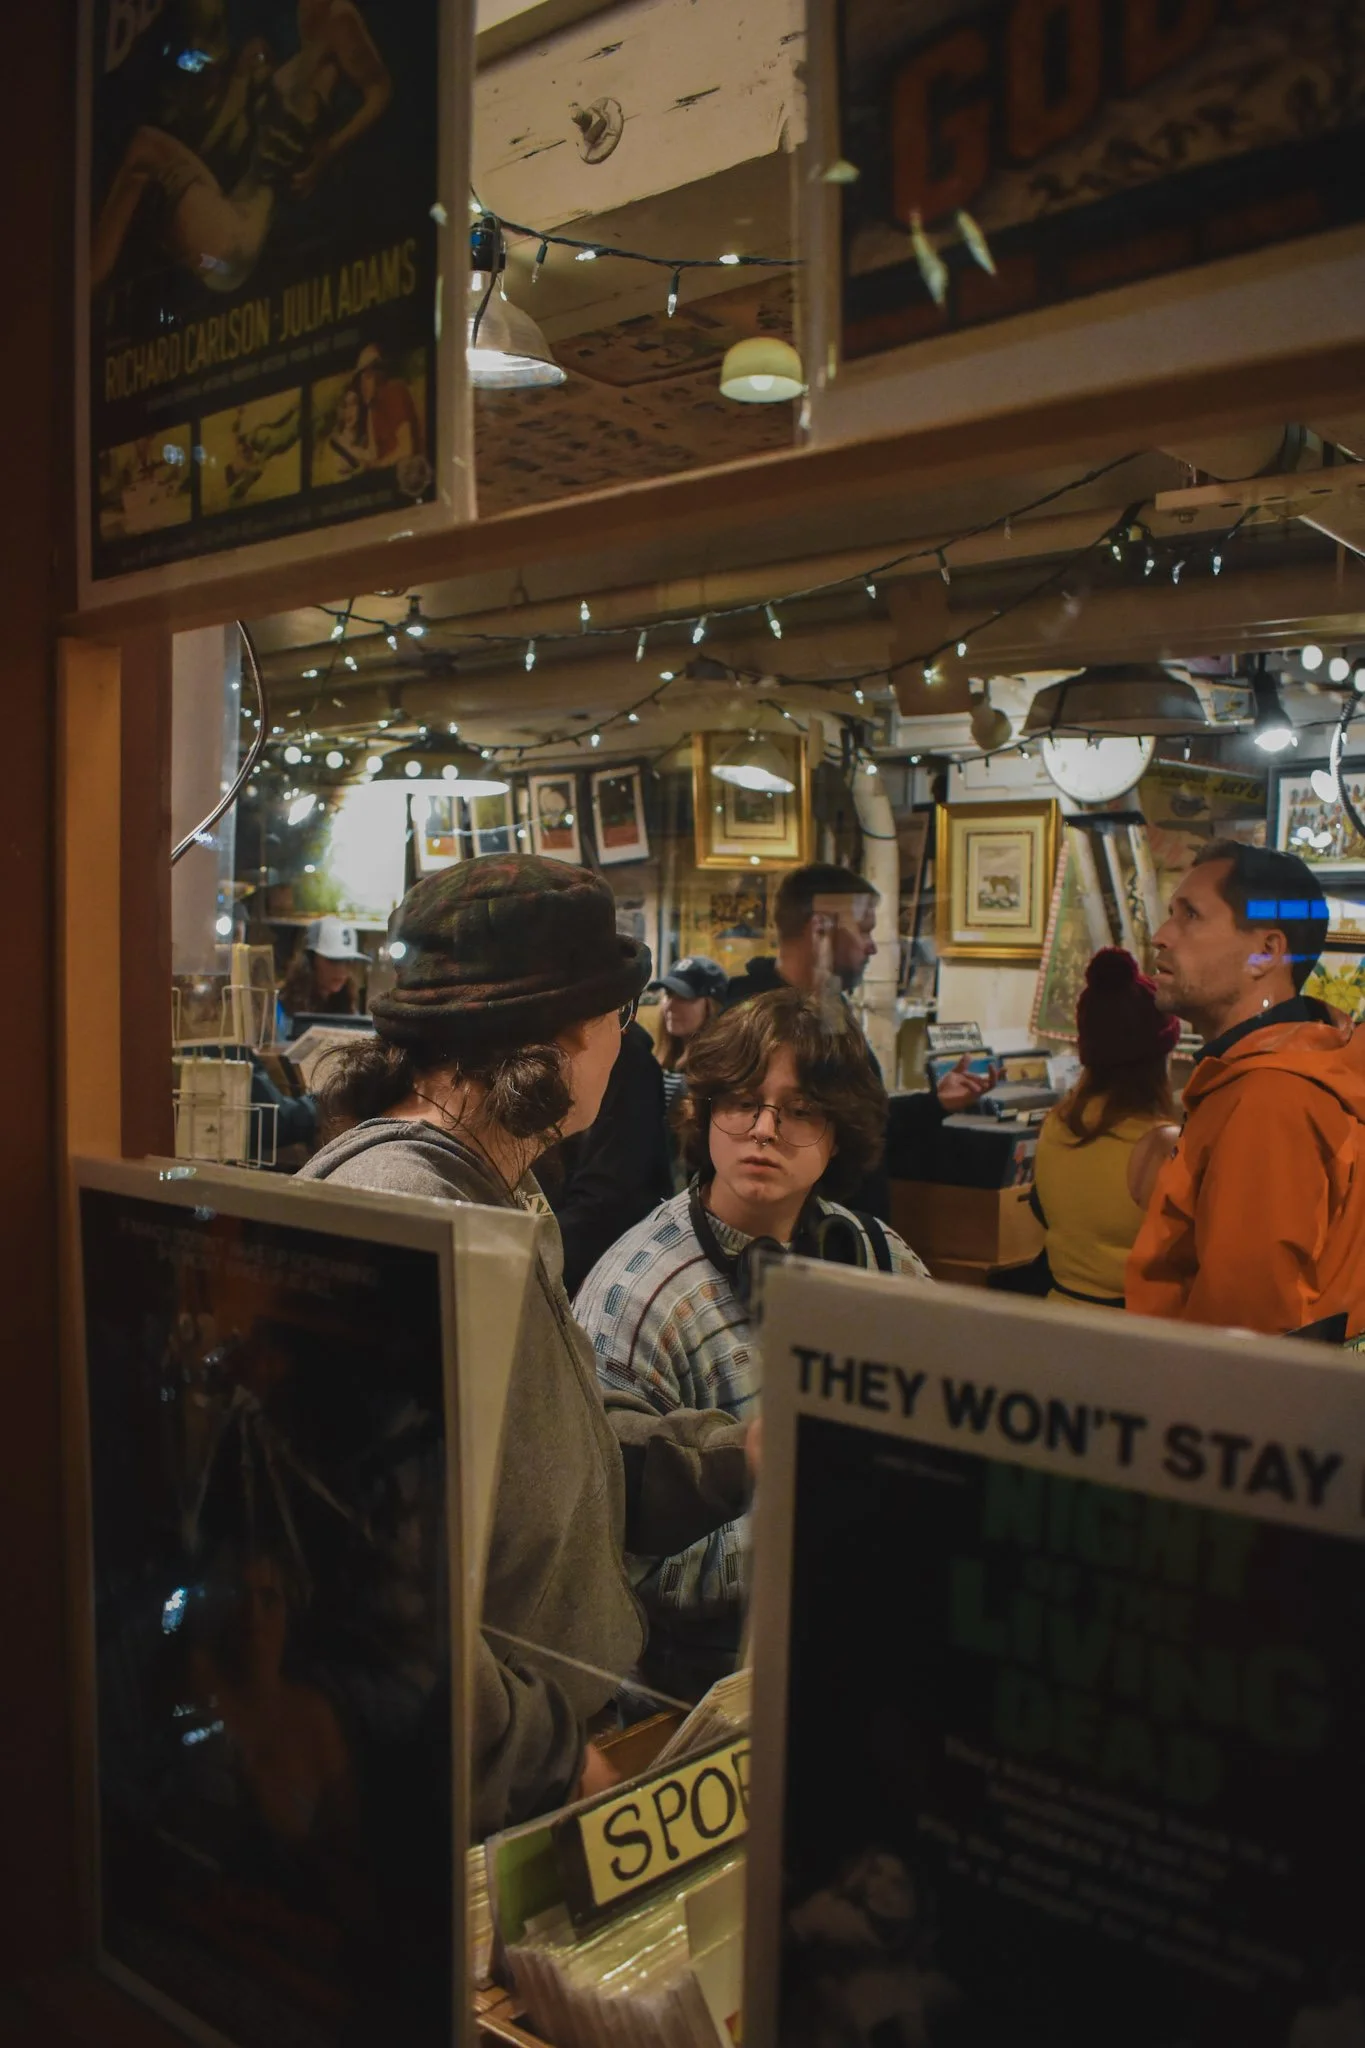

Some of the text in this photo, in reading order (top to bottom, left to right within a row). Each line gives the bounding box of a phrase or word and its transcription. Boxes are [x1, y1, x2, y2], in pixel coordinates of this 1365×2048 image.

[105, 334, 181, 404] RICHARD
[184, 297, 270, 375] CARLSON
[279, 274, 334, 342] JULIA
[337, 237, 416, 321] ADAMS
[790, 1346, 1343, 1508] THEY WON'T STAY
[982, 1461, 1256, 1600] NIGHT
[947, 1555, 1331, 1751] LIVING
[992, 1667, 1223, 1807] DEAD
